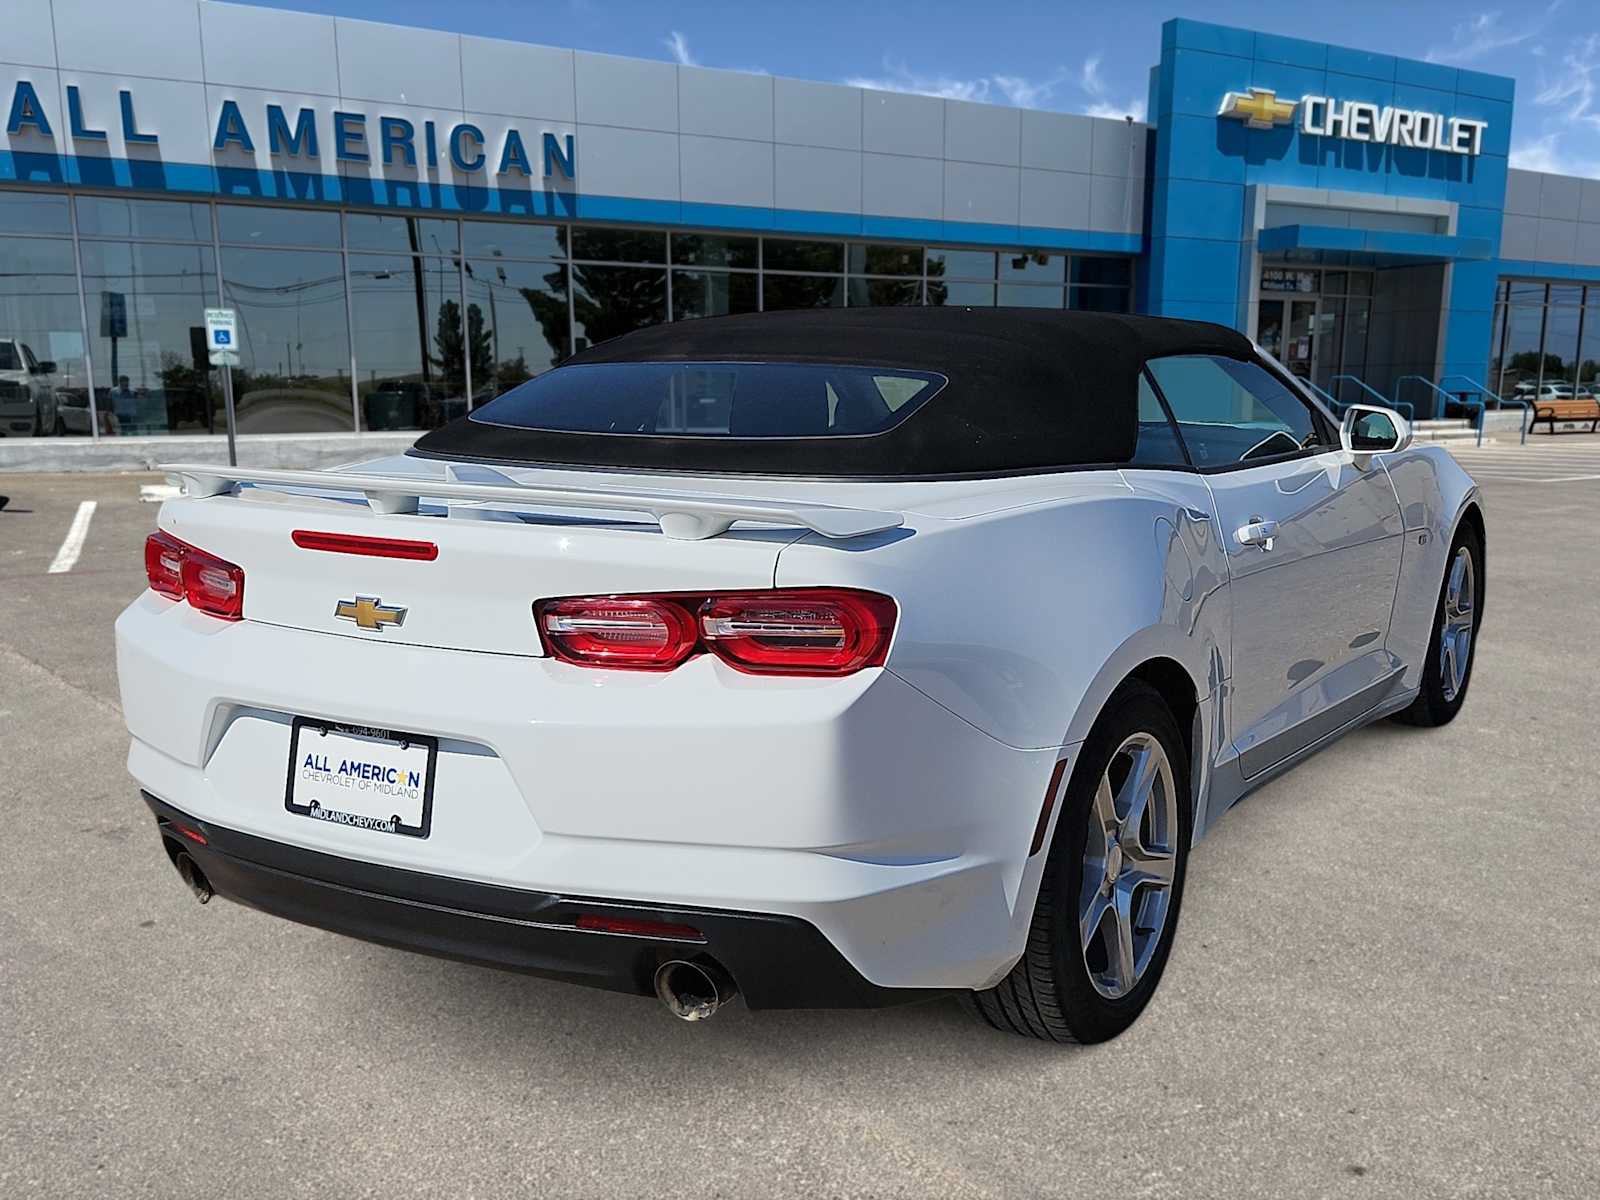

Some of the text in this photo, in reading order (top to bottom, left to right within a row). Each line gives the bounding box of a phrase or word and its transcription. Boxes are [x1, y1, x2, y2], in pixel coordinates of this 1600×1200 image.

[7, 79, 576, 180] ALL AMERICAN
[1300, 94, 1488, 156] CHEVROLET
[302, 769, 419, 800] CHEVROLET OF MIDLAND
[303, 753, 420, 788] ALL AMERICN
[310, 806, 396, 833] MIDLANDCHEVY.COM
